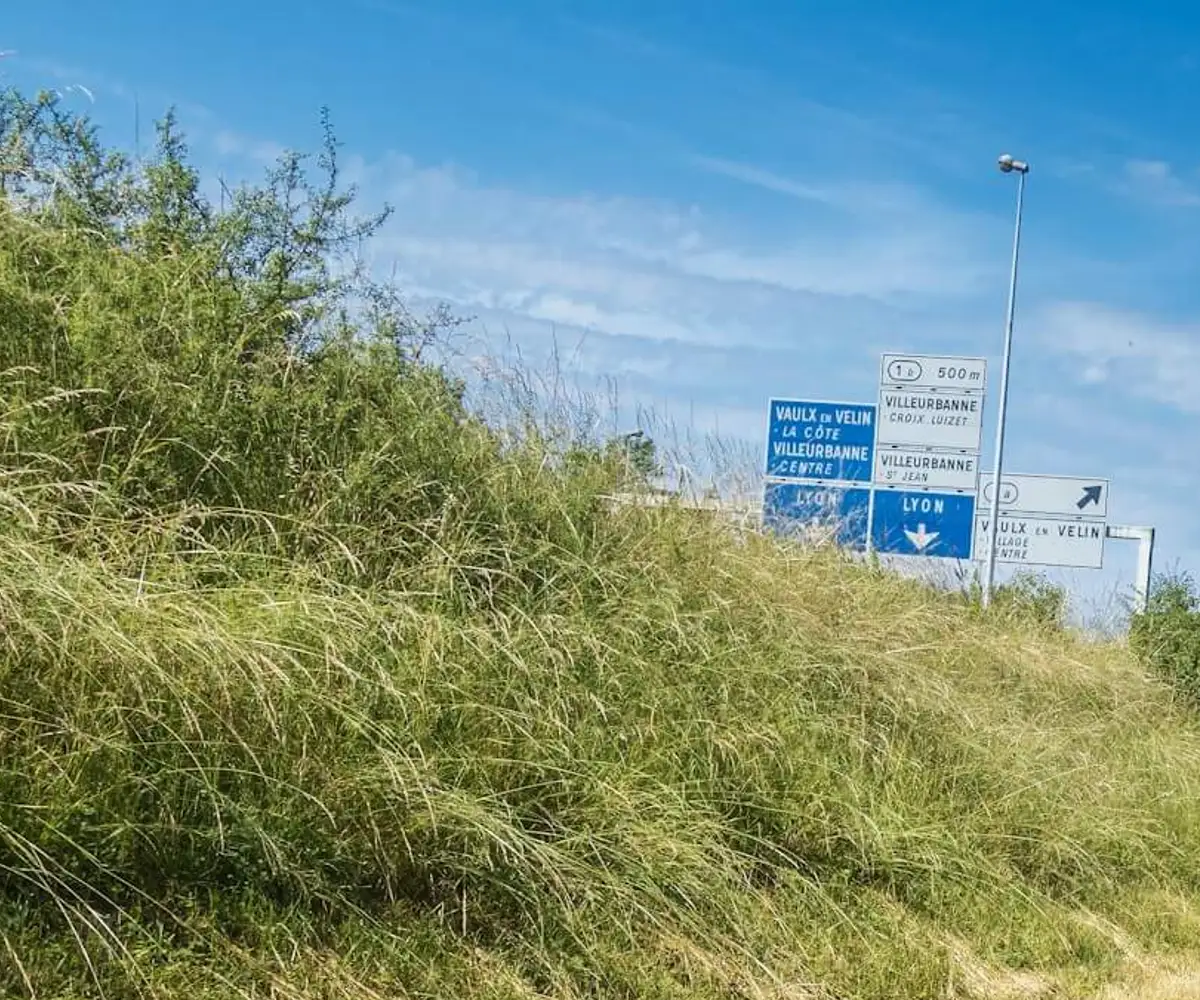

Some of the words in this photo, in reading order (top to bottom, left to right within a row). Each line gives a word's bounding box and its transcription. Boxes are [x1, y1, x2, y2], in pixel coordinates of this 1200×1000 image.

[938, 367, 967, 379] 500
[968, 372, 981, 381] m
[885, 395, 978, 413] VILLEURBANNE
[776, 405, 818, 423] VAULX
[835, 408, 873, 427] VELIN
[890, 412, 926, 425] CROIX
[931, 415, 969, 427] LUIZET
[783, 425, 798, 439] LA
[804, 423, 842, 441] CÔTE
[773, 441, 870, 462] VILLEURBANNE
[780, 459, 835, 476] CENTRE
[881, 455, 974, 473] VILLEURBANNE
[902, 471, 929, 482] JEAN
[903, 496, 945, 514] LYON
[981, 521, 1028, 534] VULX
[1058, 525, 1100, 538] VELIN
